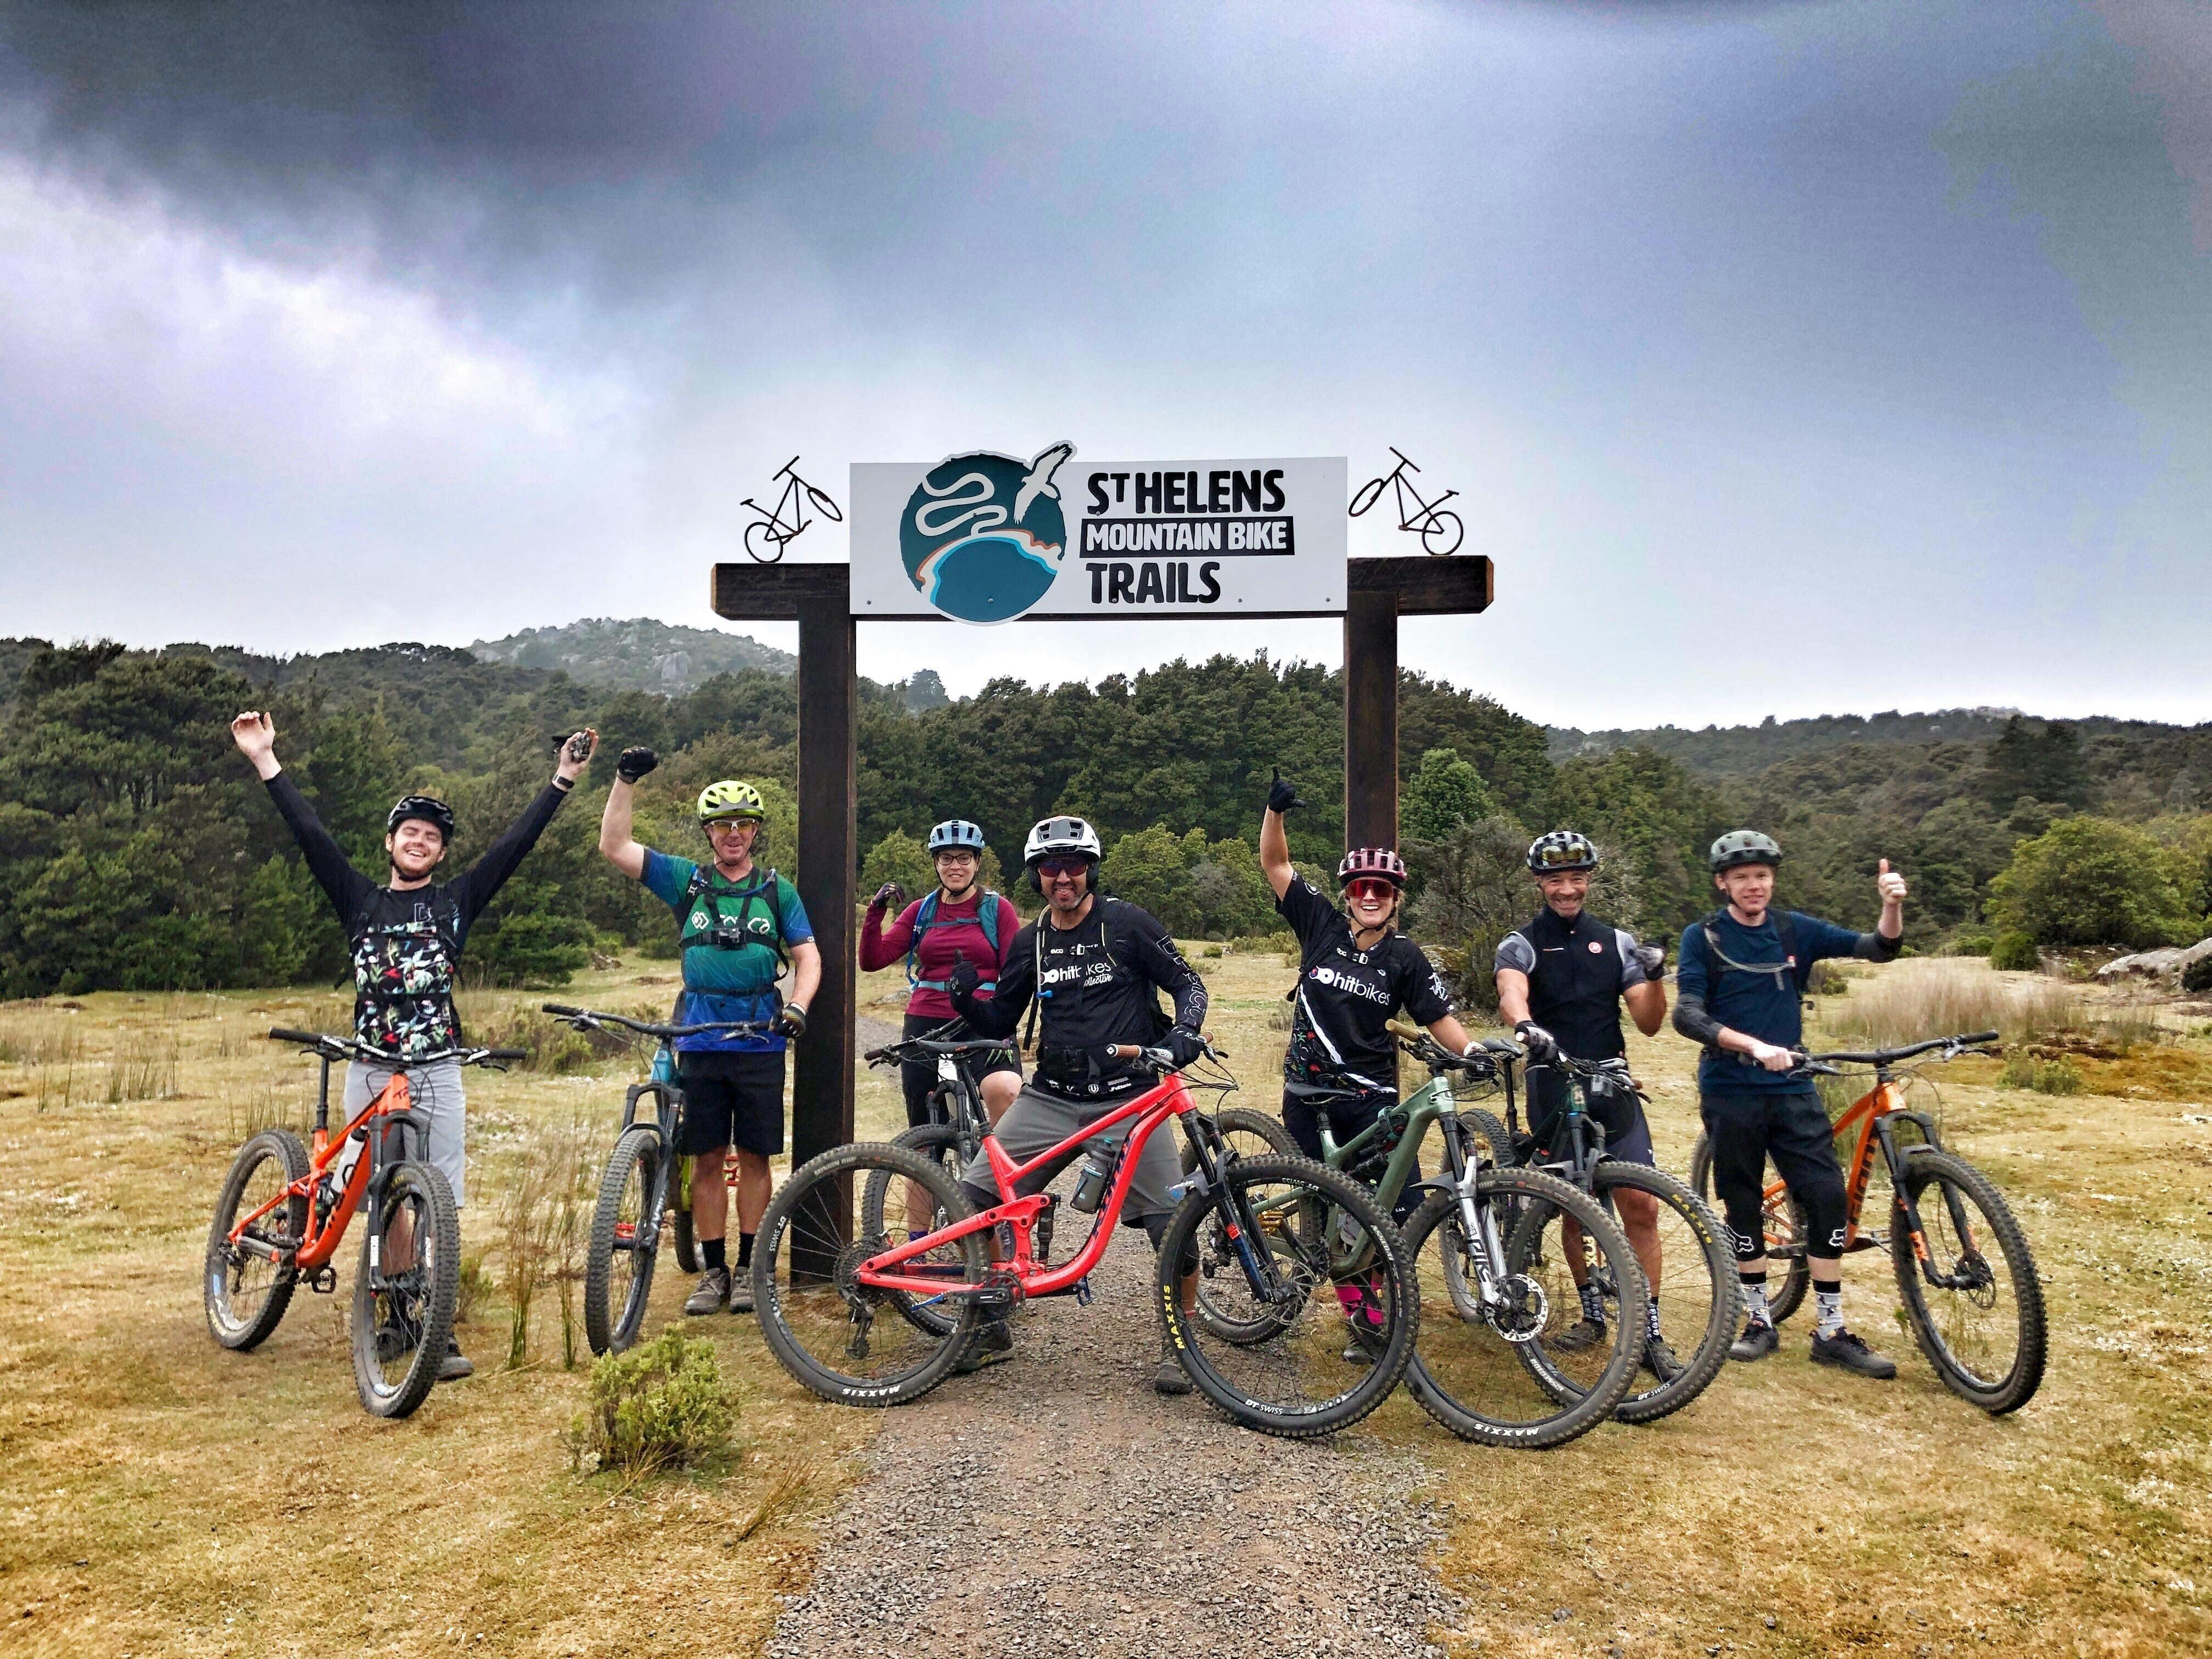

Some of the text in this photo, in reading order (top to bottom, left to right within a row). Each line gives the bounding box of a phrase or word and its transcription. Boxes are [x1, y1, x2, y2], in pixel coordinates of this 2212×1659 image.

[1135, 469, 1285, 514] HELENS
[1086, 520, 1288, 552] MOUNTAIN BIKE
[1085, 561, 1221, 604] TRAILS
[1333, 972, 1391, 1006] hitbikes
[769, 1229, 781, 1252] SWISS
[1582, 1235, 1598, 1268] FOX
[1163, 1284, 1186, 1350] MAXXIS
[842, 1384, 901, 1397] MAXXIS
[1244, 1398, 1284, 1415] DT SWISS
[1474, 1423, 1539, 1436] MAXXIS
